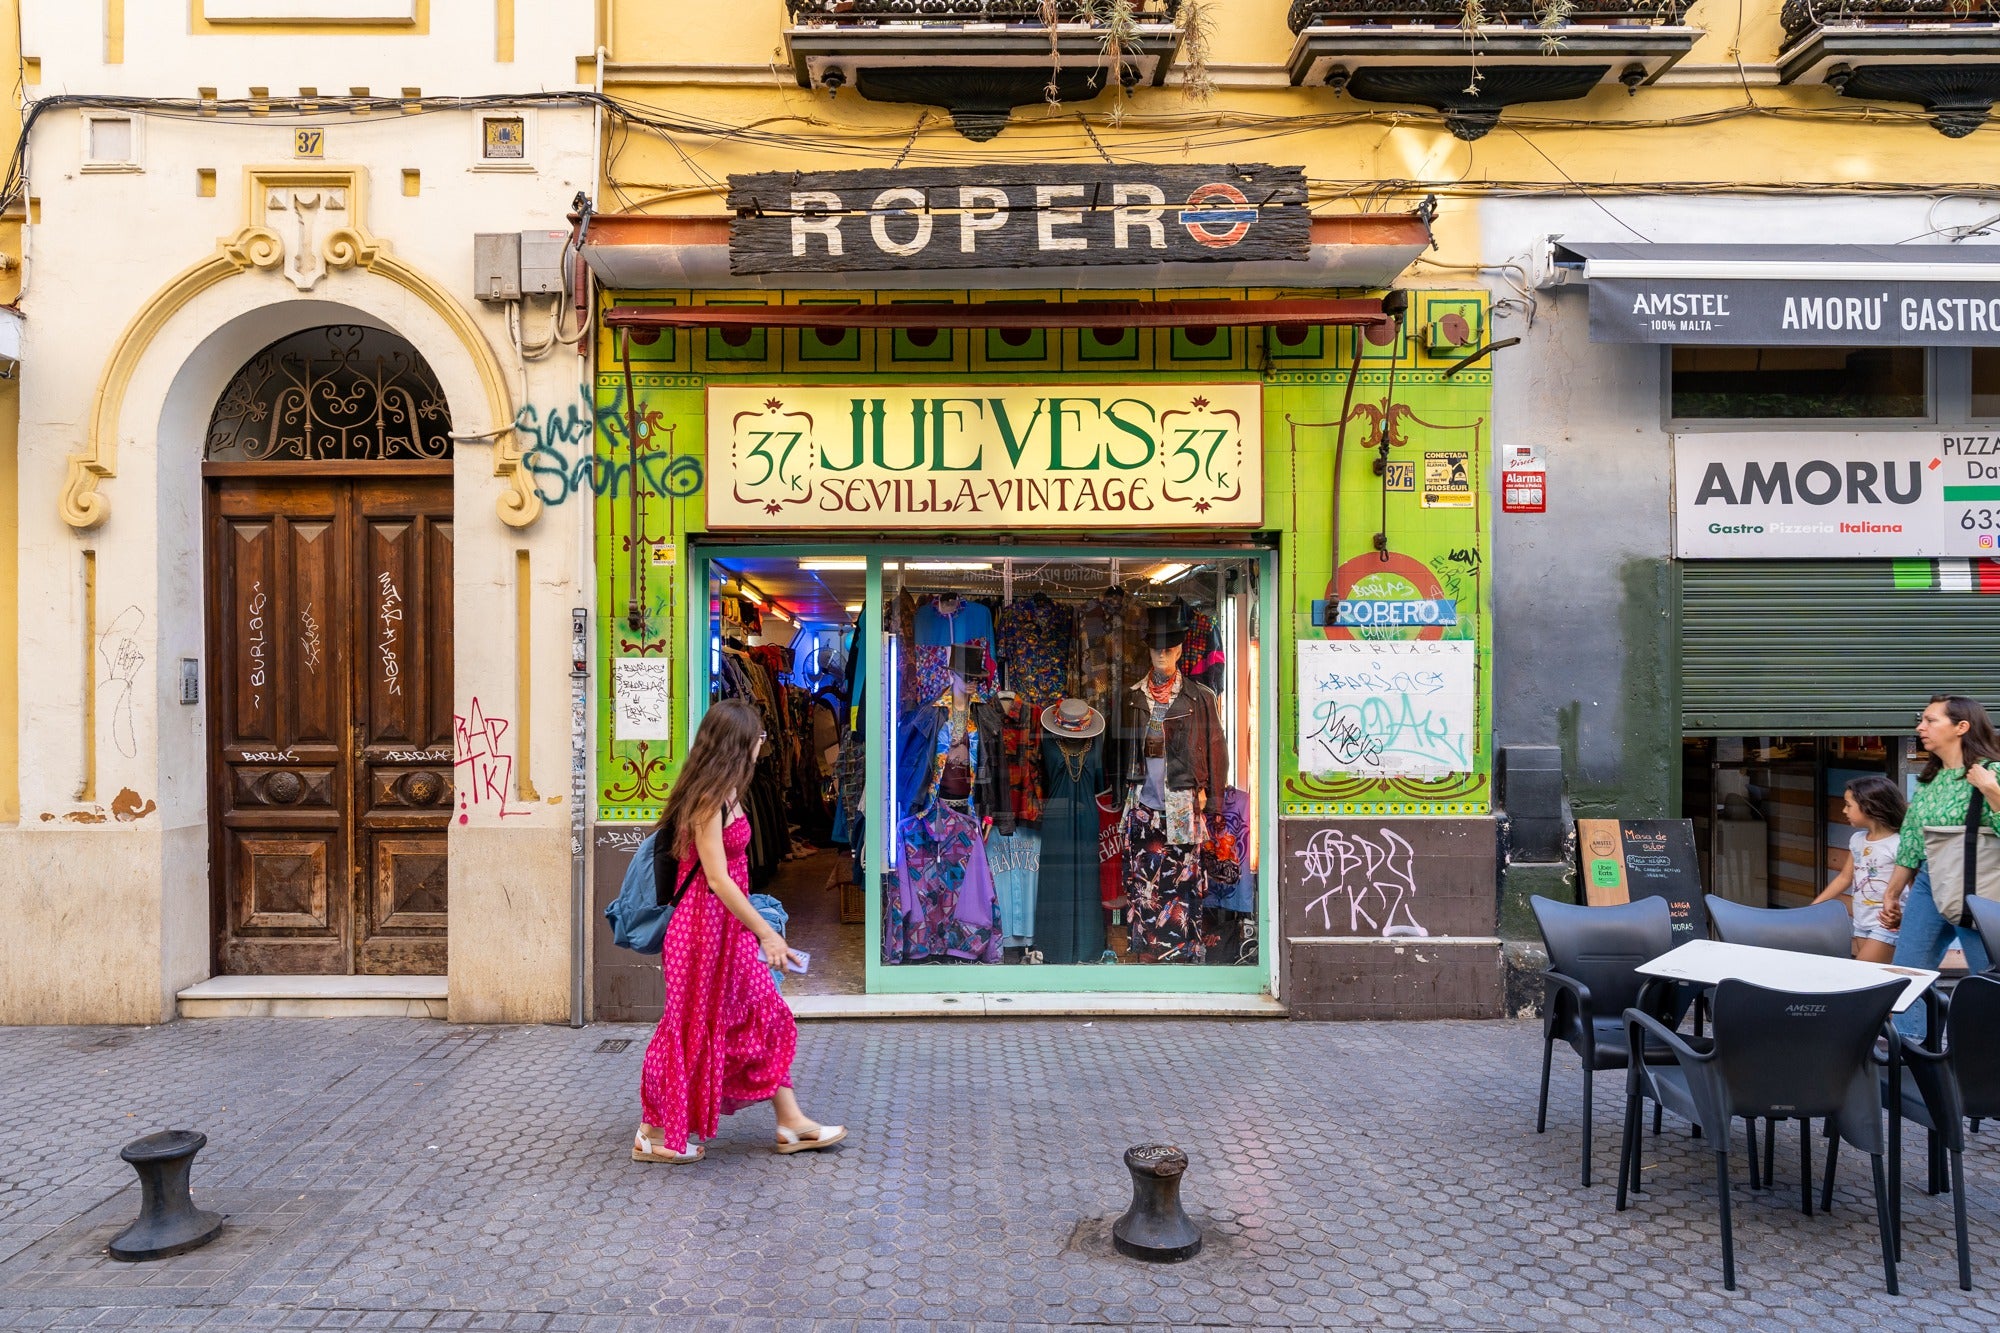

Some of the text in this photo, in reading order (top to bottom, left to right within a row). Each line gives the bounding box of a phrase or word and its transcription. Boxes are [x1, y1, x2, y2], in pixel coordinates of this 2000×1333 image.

[298, 131, 321, 153] 37
[790, 183, 1258, 257] ROPERO
[1632, 293, 1730, 316] AMSTEL
[1782, 292, 2000, 331] AMORU' GASTRO
[1650, 320, 1712, 331] 100% MALTA
[820, 397, 1156, 472] JUEVES
[1387, 465, 1404, 487] 37
[1506, 473, 1542, 482] Alarma
[1708, 521, 1903, 534] Gastro Pizzeria Italiana
[1624, 829, 1668, 841] Masa de
[990, 852, 1041, 875] HAWKS
[1671, 923, 1694, 931] HORAS
[1785, 1004, 1827, 1013] AMSTEL
